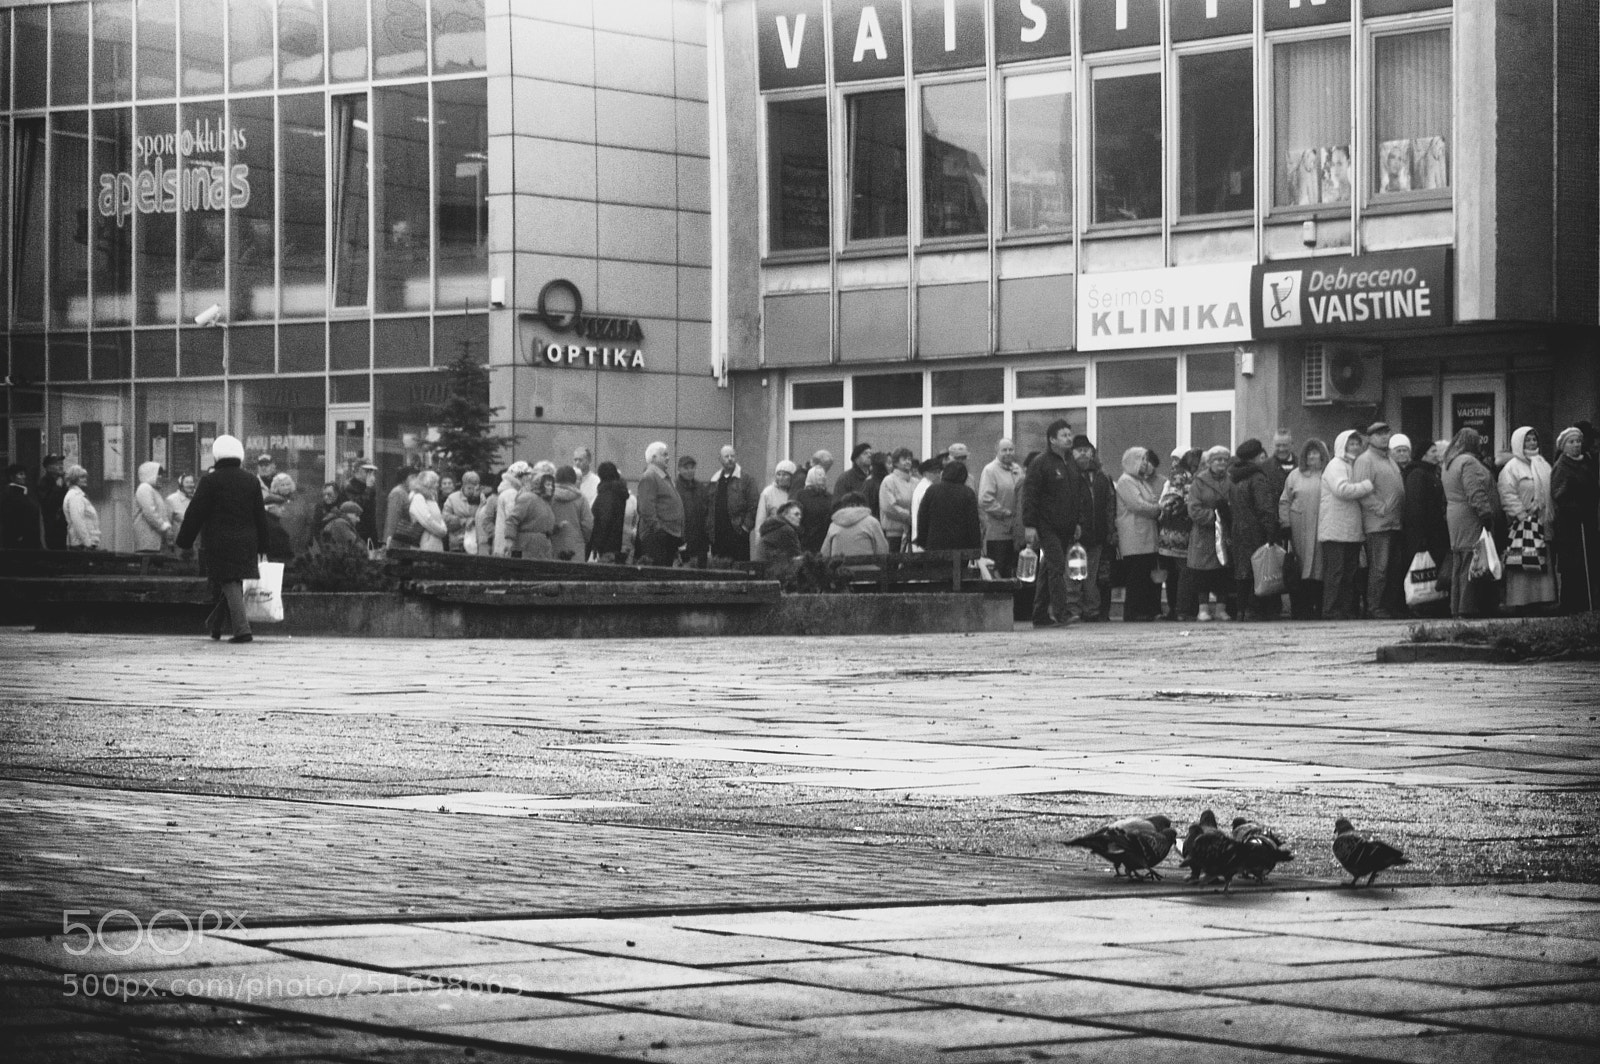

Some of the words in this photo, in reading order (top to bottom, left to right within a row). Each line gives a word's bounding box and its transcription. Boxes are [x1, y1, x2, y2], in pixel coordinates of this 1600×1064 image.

[99, 156, 250, 227] apelsinas
[1308, 267, 1417, 293] Debreceno
[1088, 284, 1164, 310] Šeimos
[1308, 280, 1432, 324] VAISTINĖ
[1091, 301, 1244, 337] KLINIKA
[547, 343, 645, 368] OPTIKA
